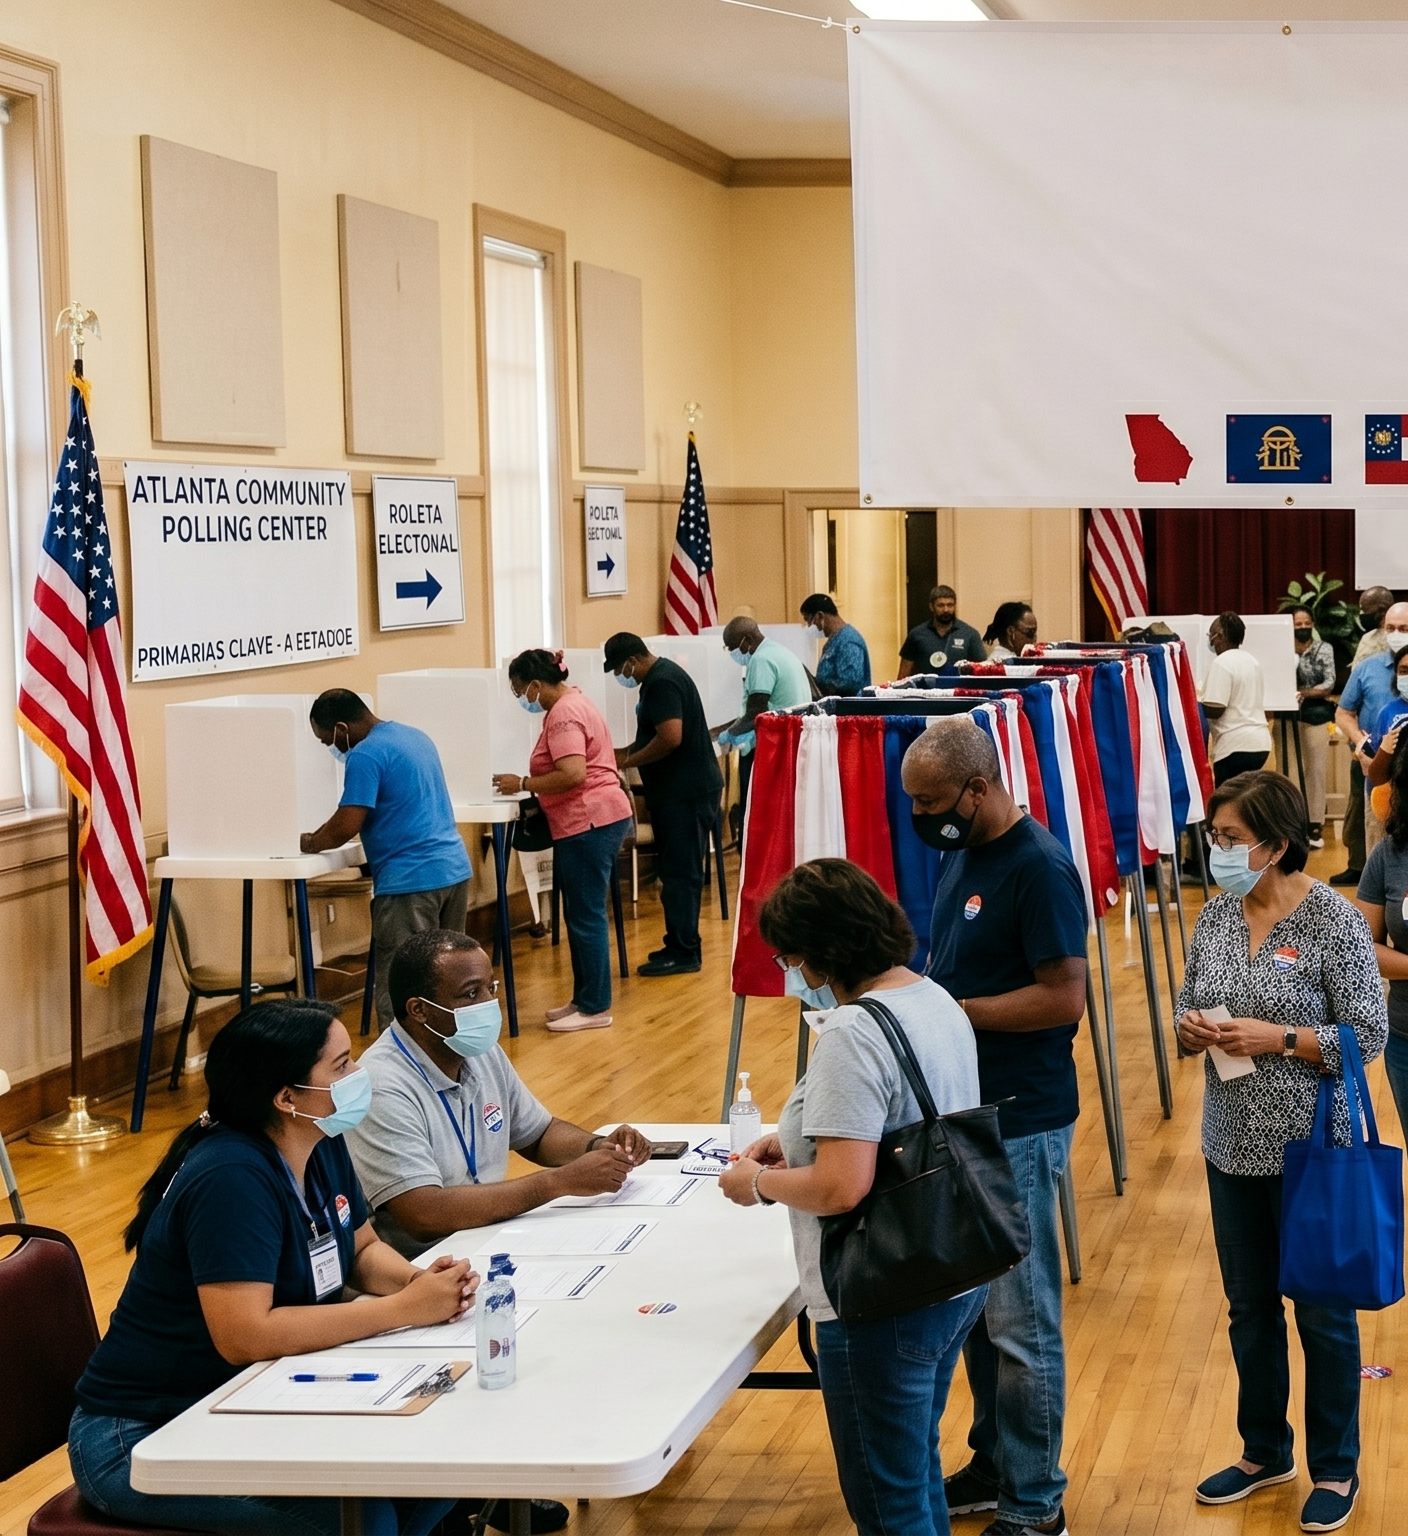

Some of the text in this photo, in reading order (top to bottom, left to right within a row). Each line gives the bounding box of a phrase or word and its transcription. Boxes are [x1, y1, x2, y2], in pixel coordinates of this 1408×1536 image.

[132, 475, 346, 506] ATLANTA COMMUNITY
[389, 504, 443, 524] ROLETA
[162, 515, 327, 543] POLLING CENTER
[378, 533, 458, 554] ELECTONAL
[138, 640, 225, 668] PRIMARIAS
[229, 635, 273, 658] CLAYE
[284, 633, 293, 652] A
